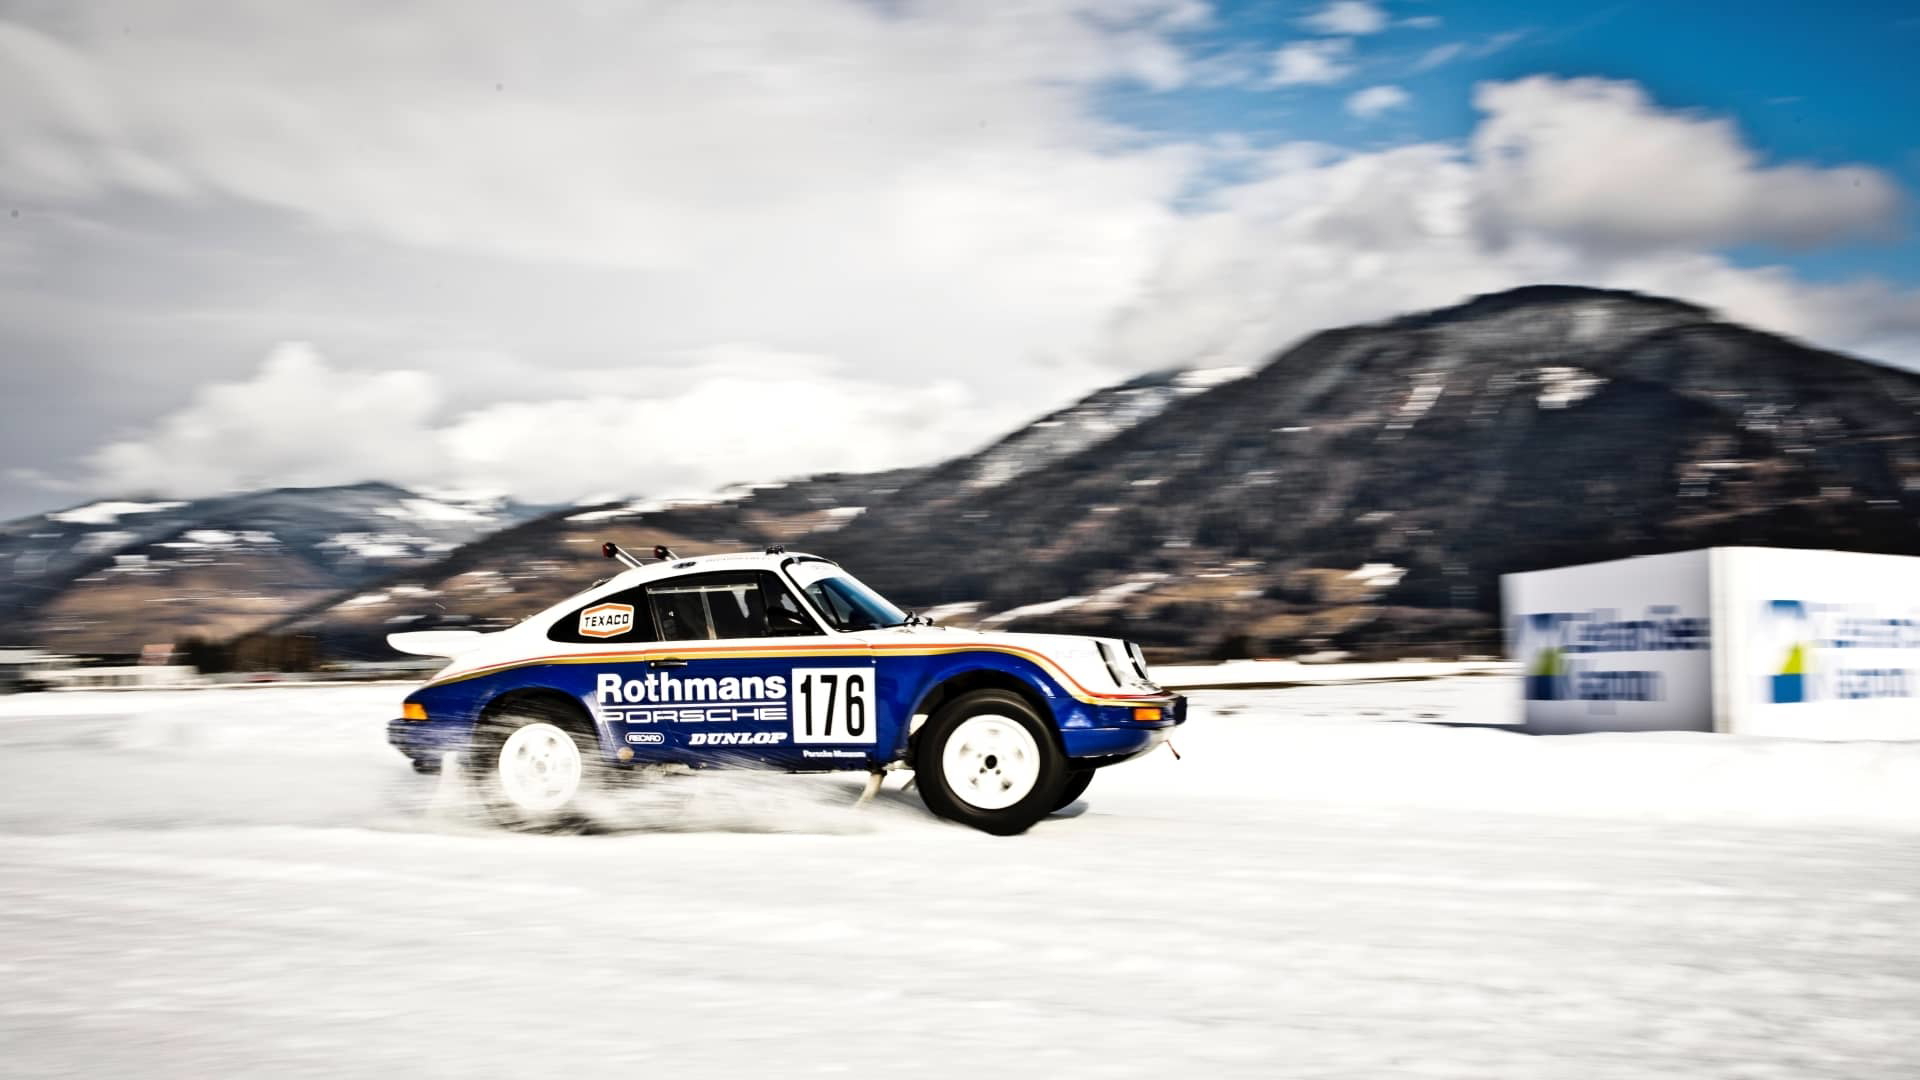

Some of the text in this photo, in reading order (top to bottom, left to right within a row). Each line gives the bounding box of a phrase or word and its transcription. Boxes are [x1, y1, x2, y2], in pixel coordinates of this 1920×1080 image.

[585, 613, 630, 628] TEXACO
[597, 672, 787, 703] Rothmans
[800, 674, 865, 736] 176
[598, 707, 788, 724] PORSCHE
[688, 732, 788, 745] DUNLOP
